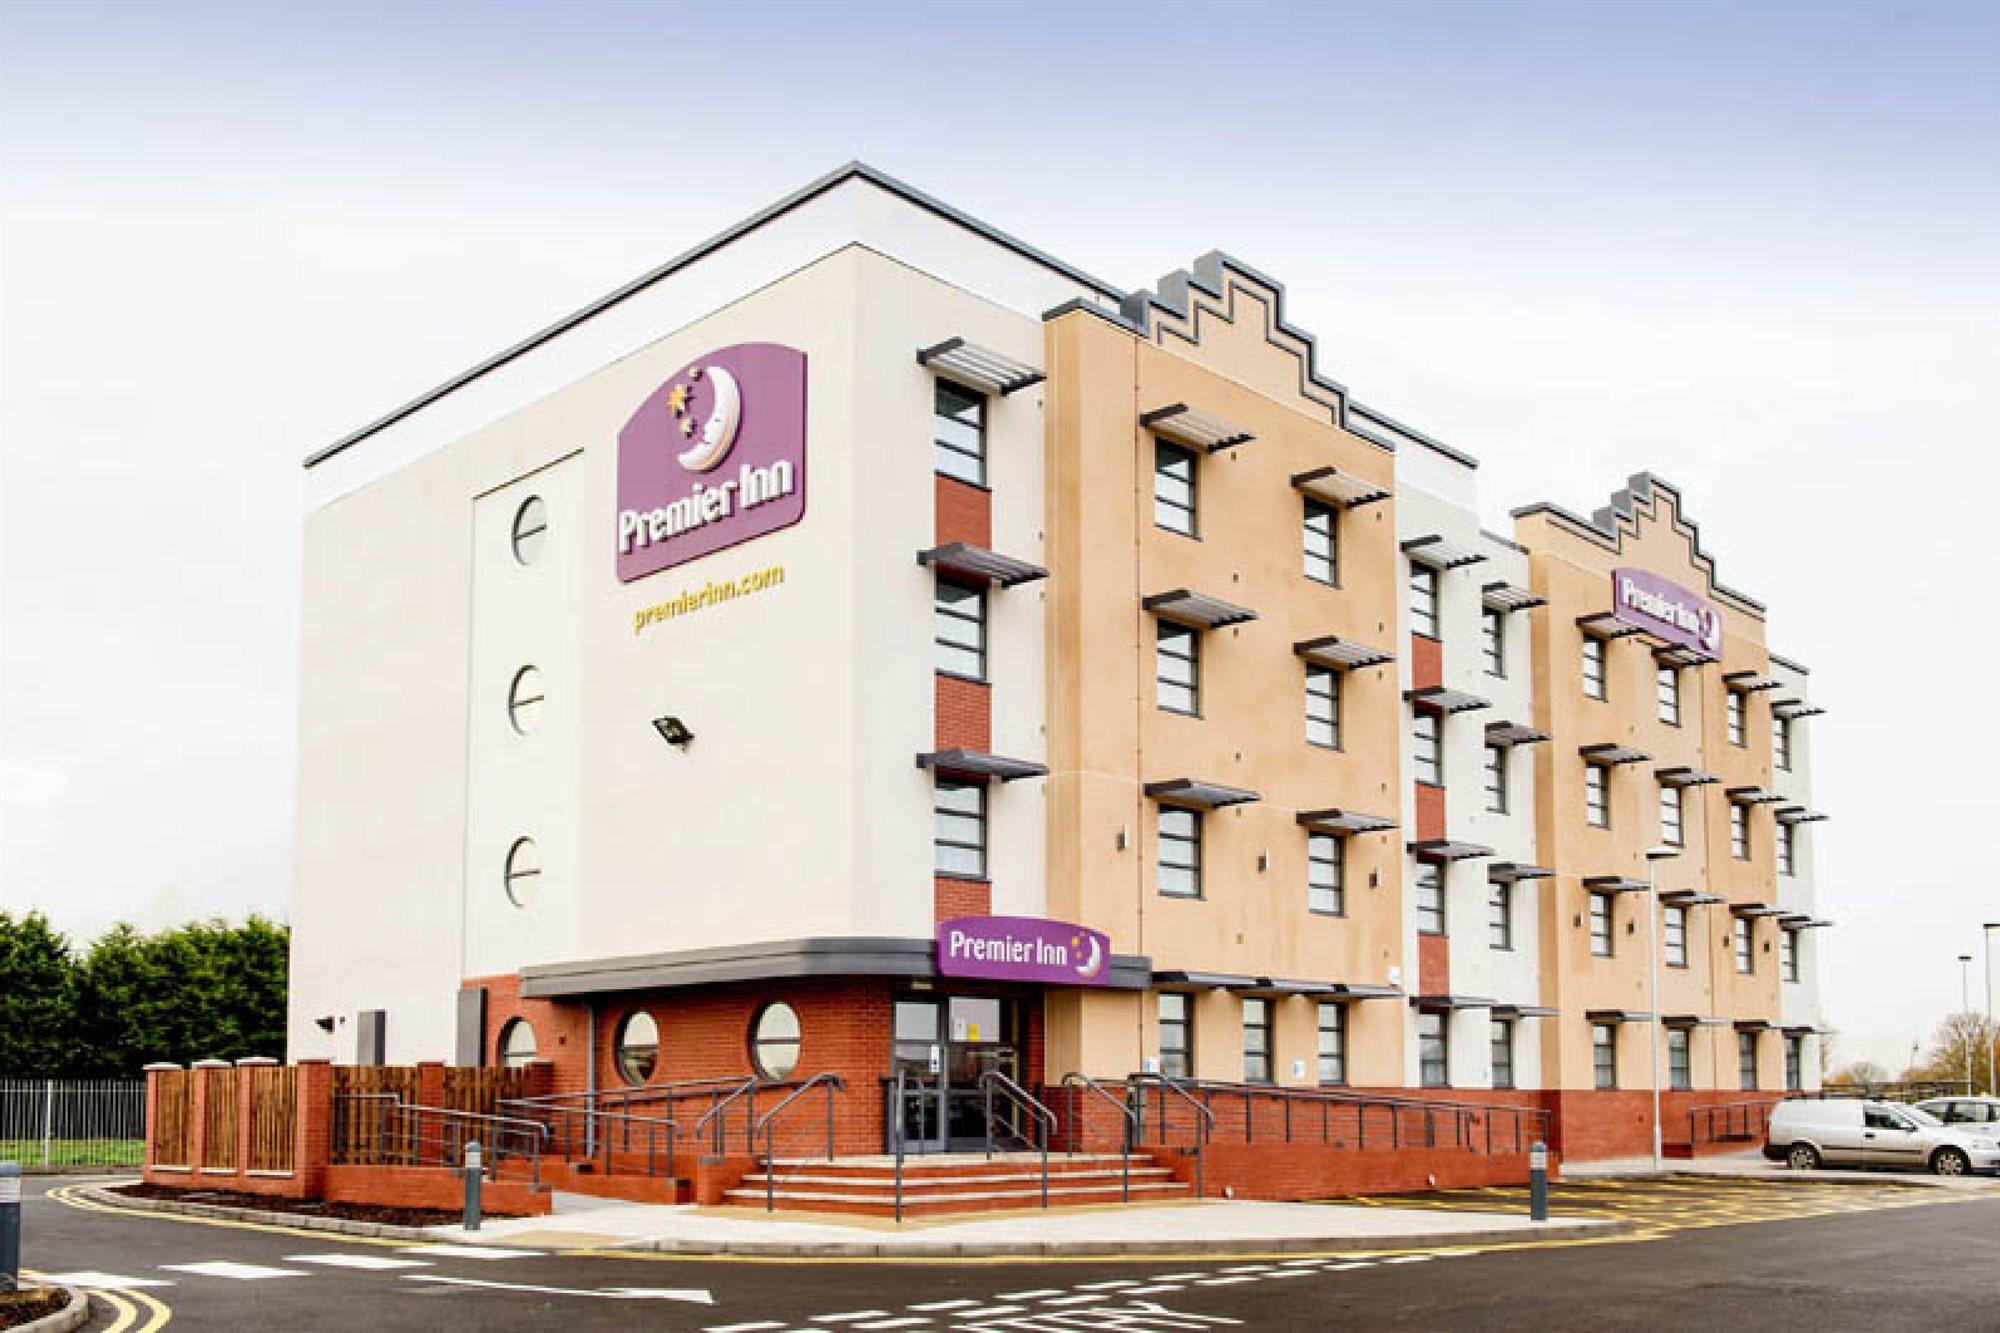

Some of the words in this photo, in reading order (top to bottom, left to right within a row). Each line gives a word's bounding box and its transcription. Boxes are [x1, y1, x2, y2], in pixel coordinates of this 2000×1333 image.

[619, 480, 740, 553] Premier
[740, 459, 795, 508] Inn
[632, 566, 785, 634] premierinn.com
[1622, 577, 1676, 623] Premier
[1676, 601, 1699, 635] Inn
[950, 930, 1034, 963] Premier
[1036, 937, 1068, 965] Inn
